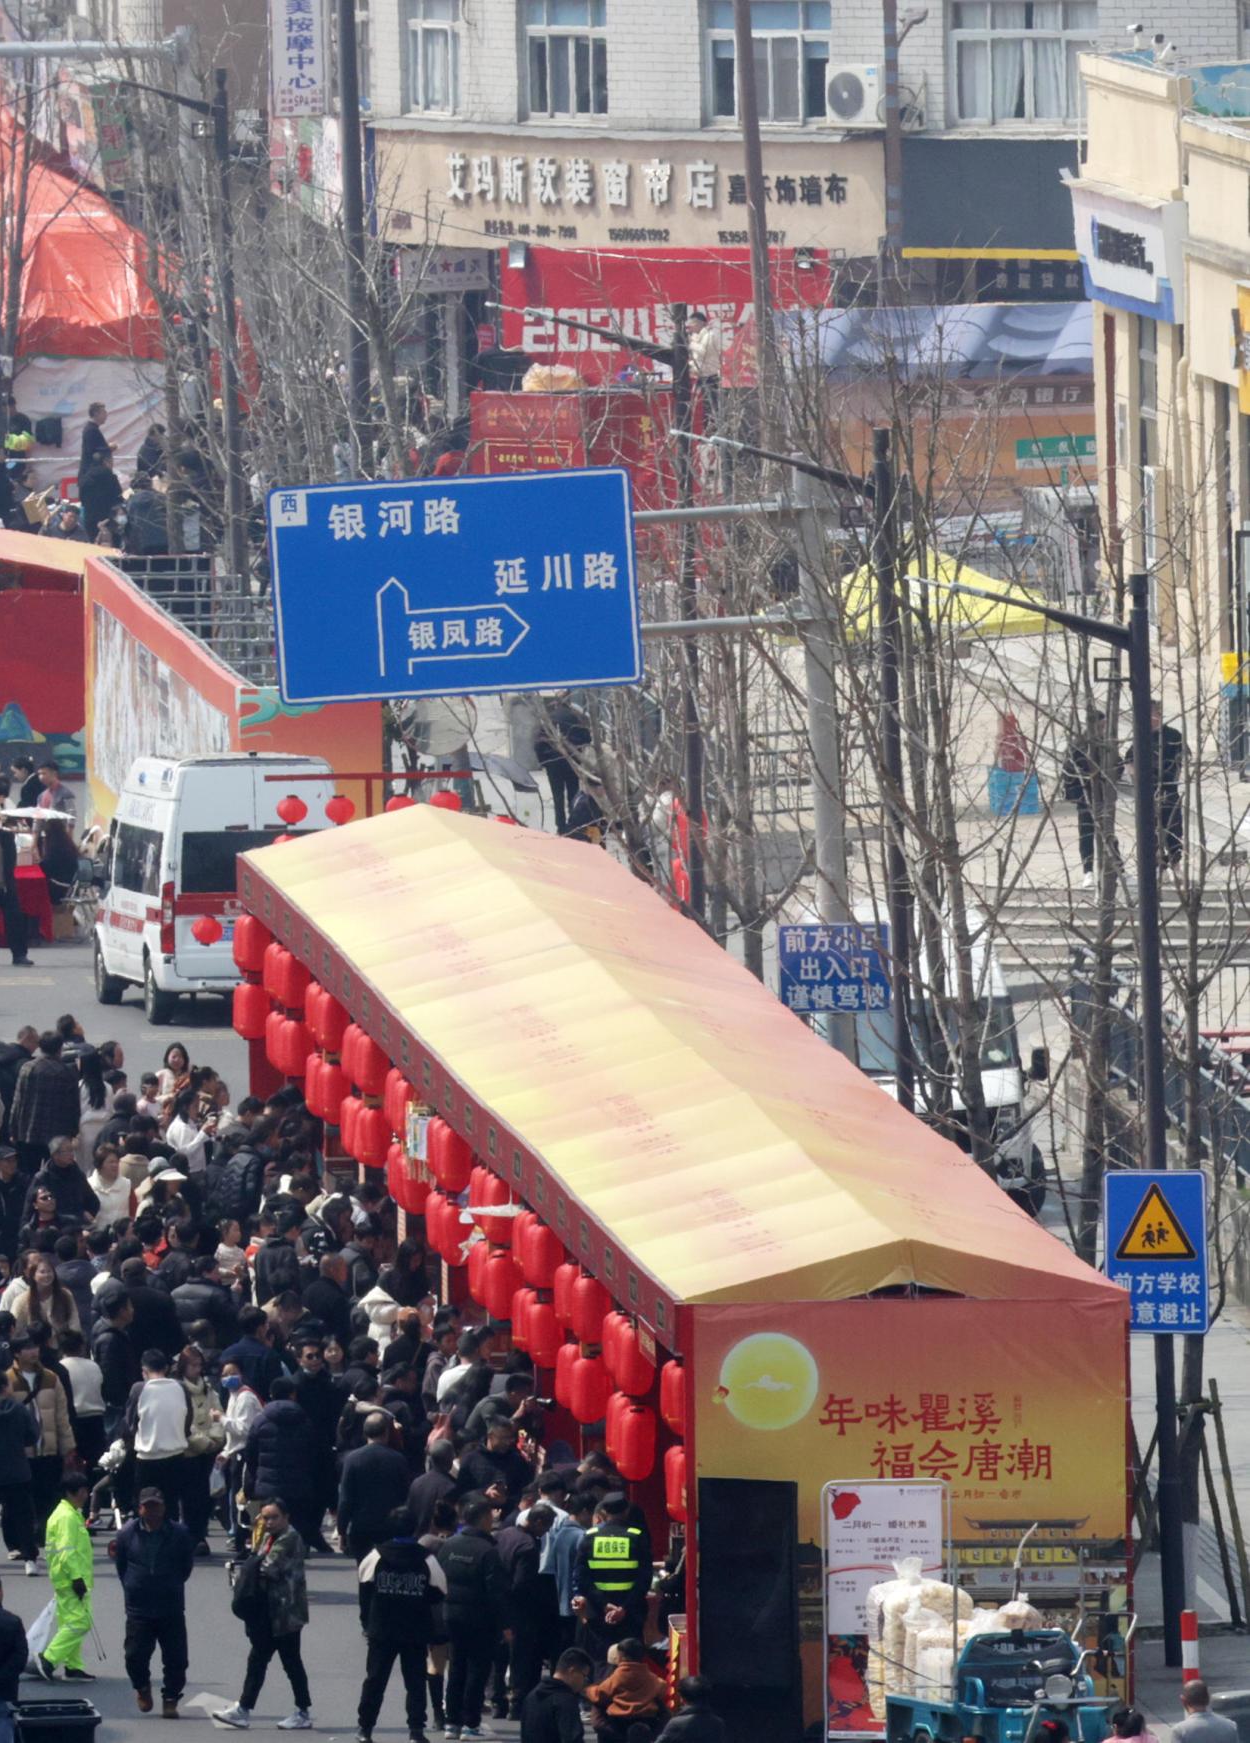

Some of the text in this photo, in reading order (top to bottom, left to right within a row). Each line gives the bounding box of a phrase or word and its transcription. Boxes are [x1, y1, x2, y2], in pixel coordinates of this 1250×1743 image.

[445, 152, 717, 208] 艾玛斯软装窗帘店
[728, 173, 849, 206] 嘉饰墙布
[280, 493, 298, 514] 西
[328, 496, 461, 541] 银河路
[494, 551, 619, 596] 延川路
[407, 616, 505, 651] 银凤路
[784, 926, 880, 954] 前方小区
[800, 956, 871, 979] 出入口
[786, 985, 886, 1010] 谨慎驾驶
[1113, 1272, 1201, 1296] 前方学校
[1130, 1303, 1202, 1325] 意避让
[818, 1392, 1003, 1436] 年味瞿溪
[870, 1437, 1053, 1482] 福会唐潮
